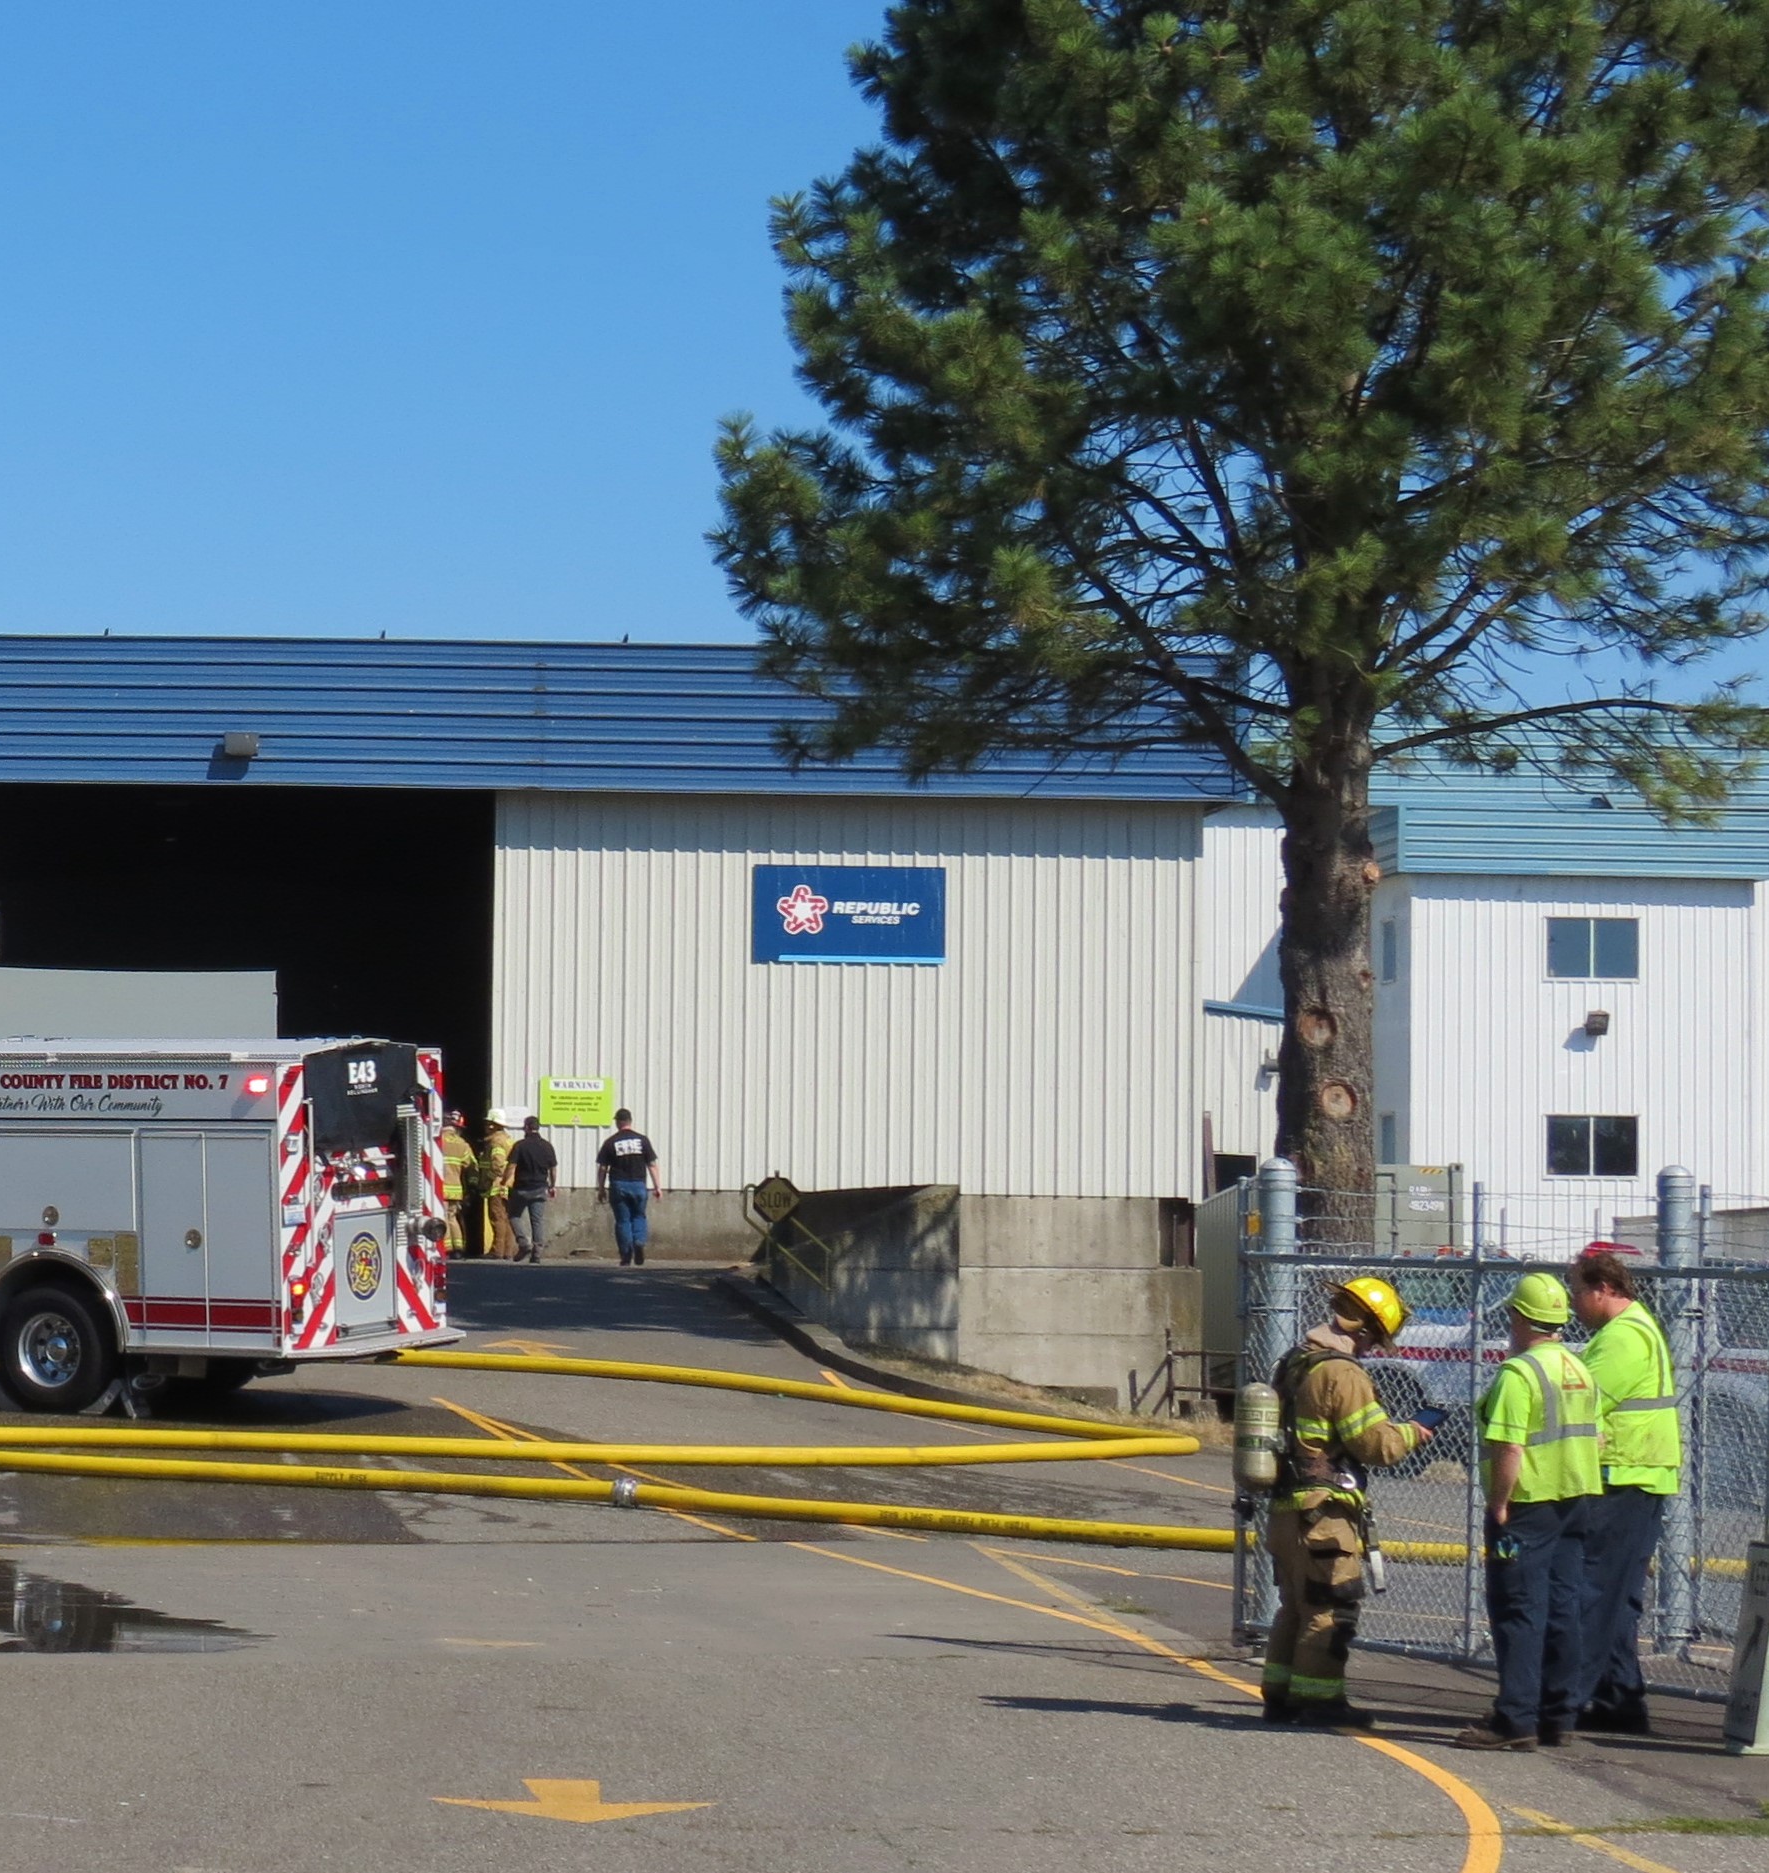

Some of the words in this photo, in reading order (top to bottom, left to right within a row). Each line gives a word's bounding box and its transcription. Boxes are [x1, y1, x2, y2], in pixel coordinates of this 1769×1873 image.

[832, 901, 920, 916] REPUBLIC
[851, 915, 900, 925] SERVICES
[348, 1060, 377, 1084] E43
[0, 1074, 66, 1089] COUNTY
[69, 1074, 103, 1089] FIRE
[107, 1074, 180, 1090] DISTRICT
[183, 1074, 213, 1090] NO.
[218, 1074, 229, 1090] 7
[553, 1081, 600, 1089] WARNING
[31, 1093, 66, 1112] With
[70, 1093, 94, 1112] Our
[98, 1092, 164, 1117] Community
[760, 1191, 791, 1209] SLOW
